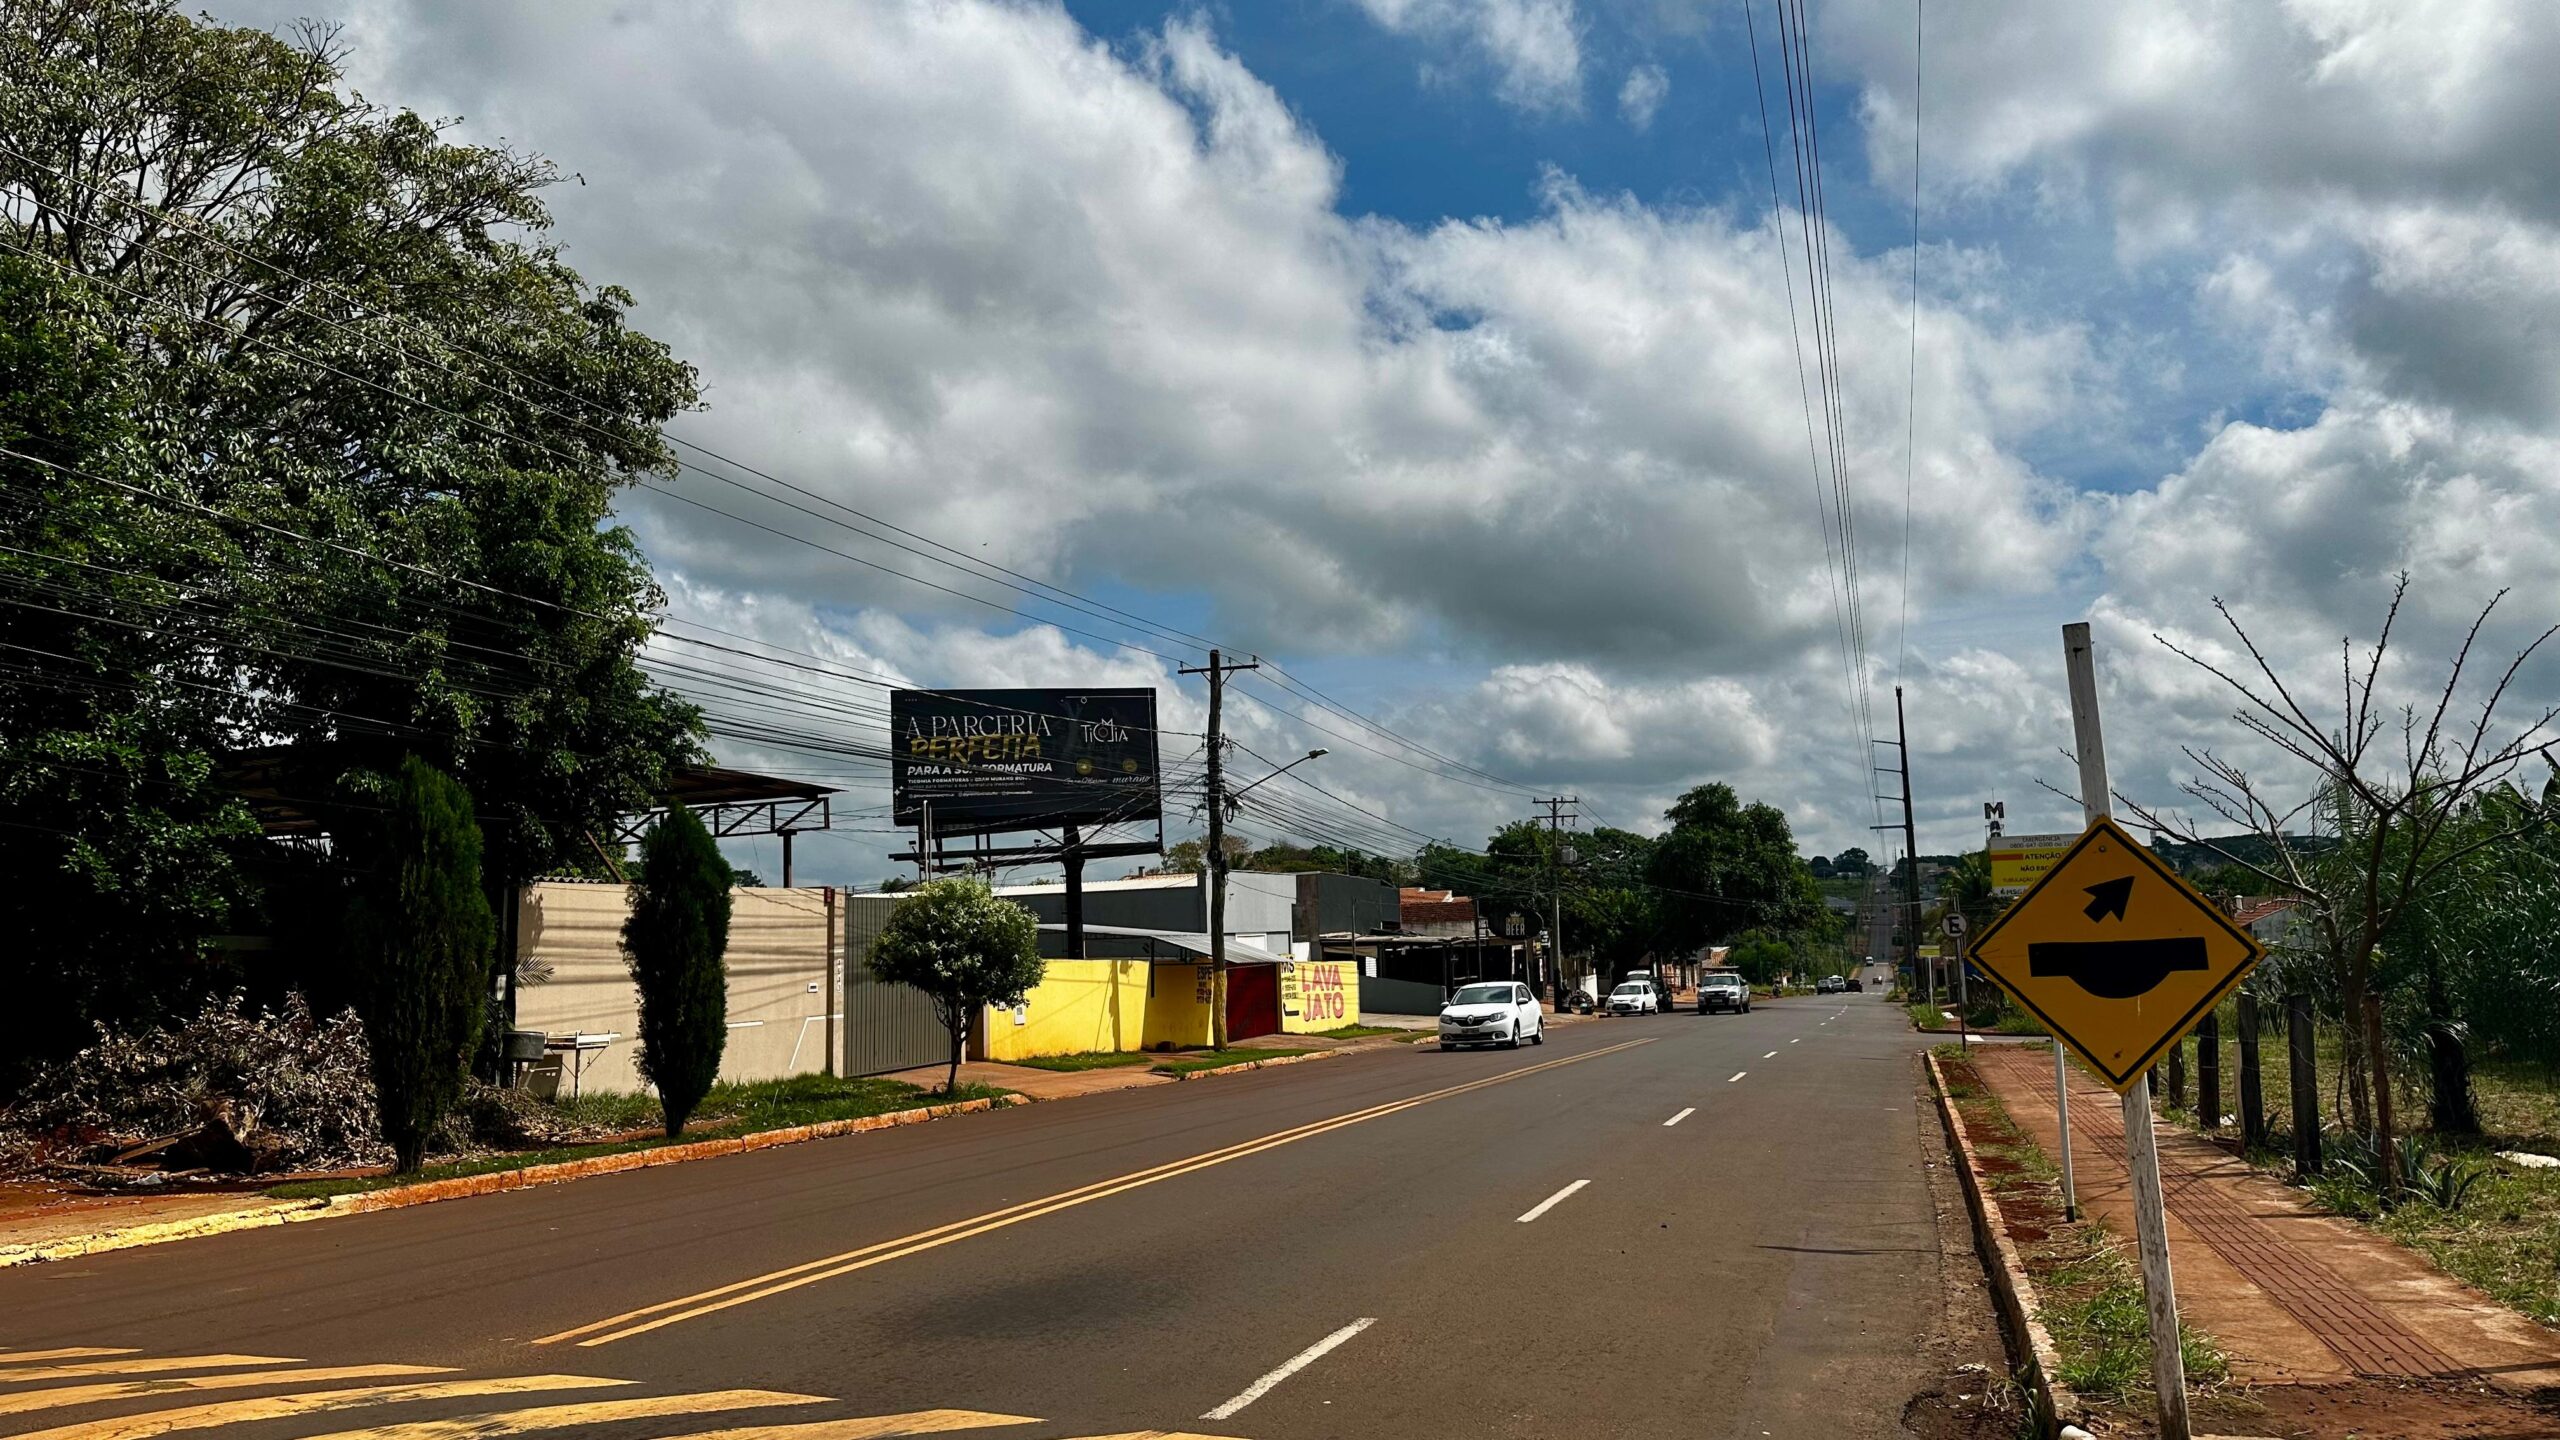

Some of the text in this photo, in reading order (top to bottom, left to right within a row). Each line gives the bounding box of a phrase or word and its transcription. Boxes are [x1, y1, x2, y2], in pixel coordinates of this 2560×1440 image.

[905, 714, 1052, 740] A PARCERIA
[910, 732, 1041, 764] PERFEITA
[907, 766, 940, 776] PARA
[942, 766, 952, 775] A
[980, 763, 1053, 774] FORMATURA
[1112, 776, 1151, 785] murano
[2022, 835, 2061, 843] EMERGÊNCIA
[2025, 852, 2061, 861] ATENÇÃO
[1505, 923, 1525, 936] BEER
[1948, 916, 1961, 934] E
[1302, 964, 1344, 992] LAVA
[1302, 992, 1345, 1022] JATO
